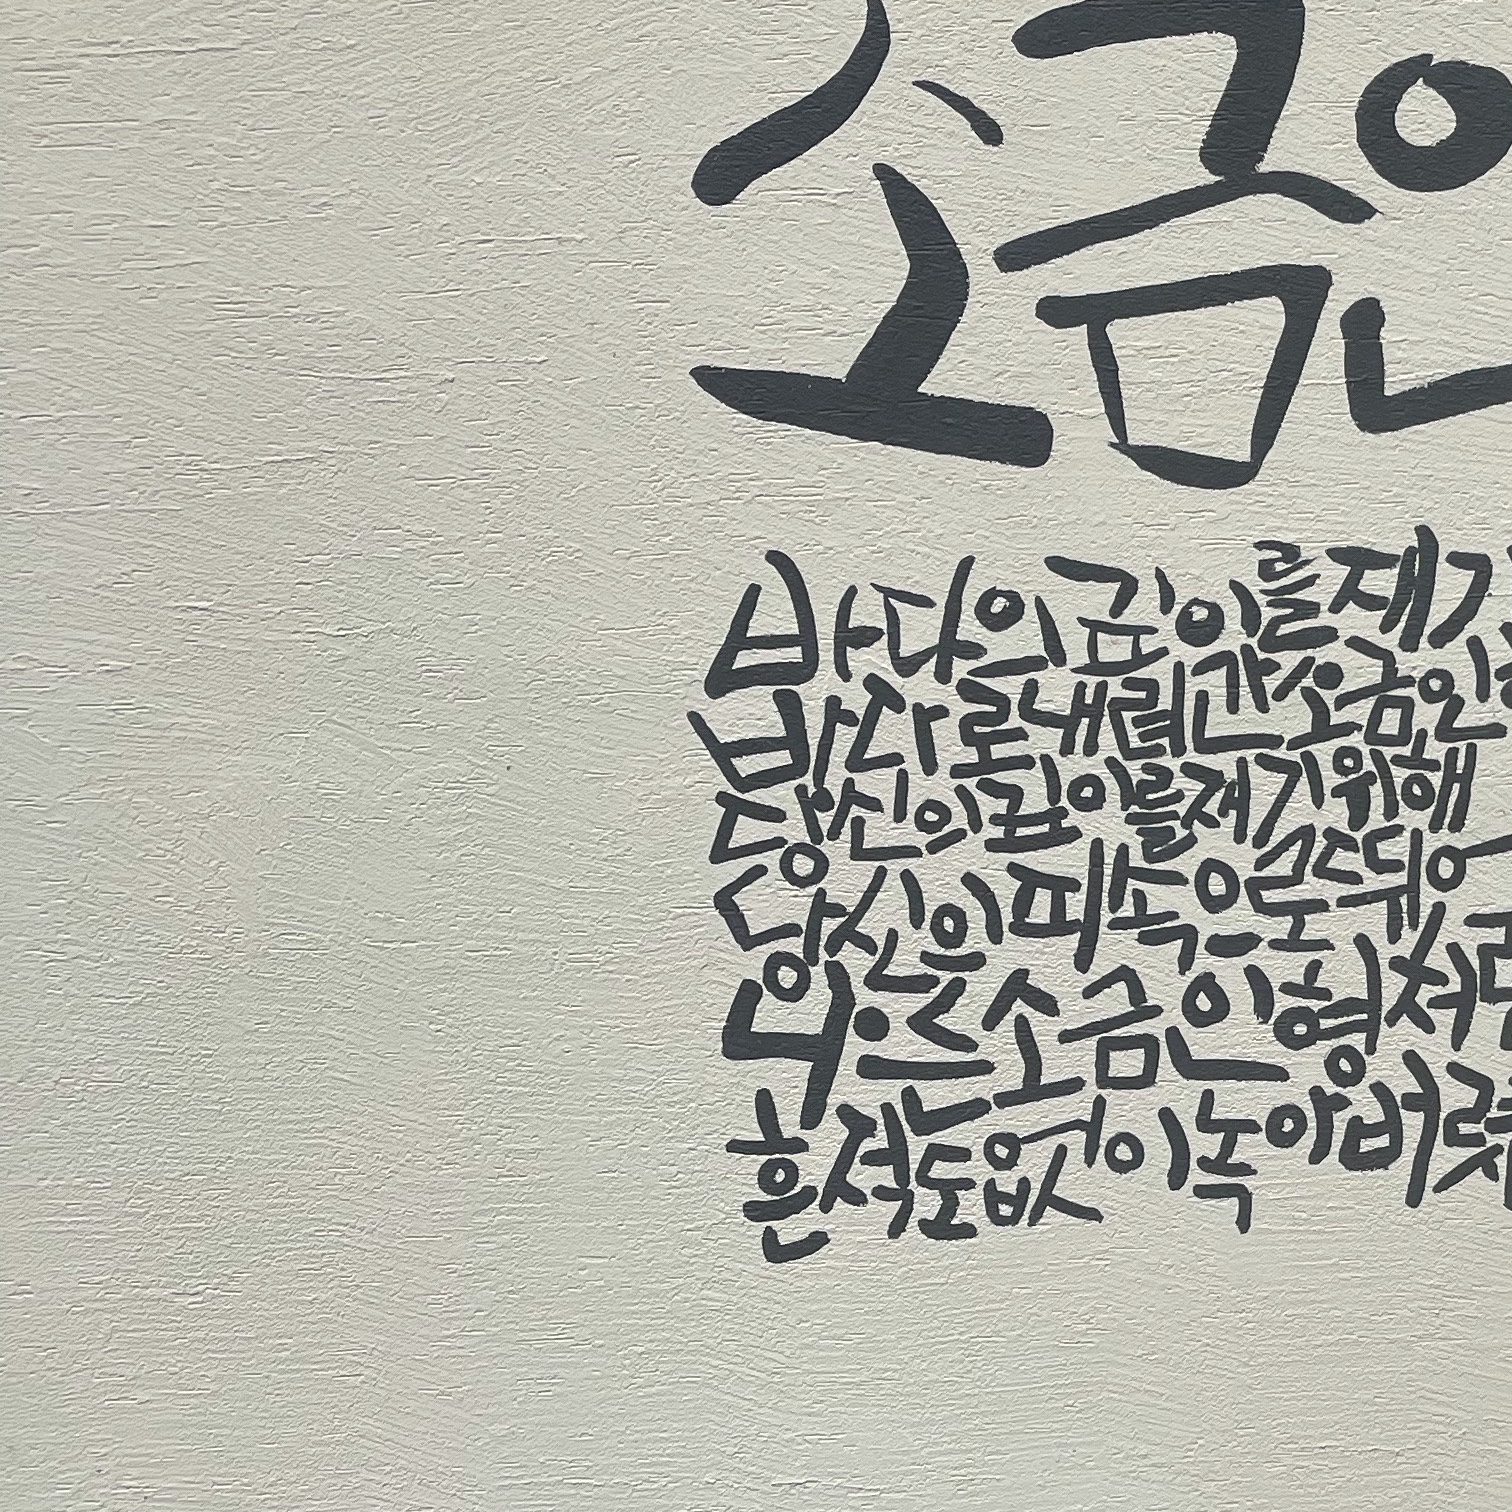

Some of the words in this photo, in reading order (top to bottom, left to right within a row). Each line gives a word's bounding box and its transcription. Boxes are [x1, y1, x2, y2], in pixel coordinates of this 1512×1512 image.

[704, 550, 1066, 698] 바다의
[1044, 540, 1340, 676] 깊이를
[687, 673, 1036, 793] 바다로
[1018, 643, 1284, 760] 내려간
[709, 769, 983, 888] 당신의
[976, 754, 1198, 864] 깊이를
[1180, 750, 1325, 848] 재기
[1331, 729, 1478, 833] 위해
[714, 865, 1004, 1002] 당신의
[722, 960, 996, 1137] 나는
[726, 1088, 979, 1264] 흔적도
[983, 1094, 1190, 1227] 없이
